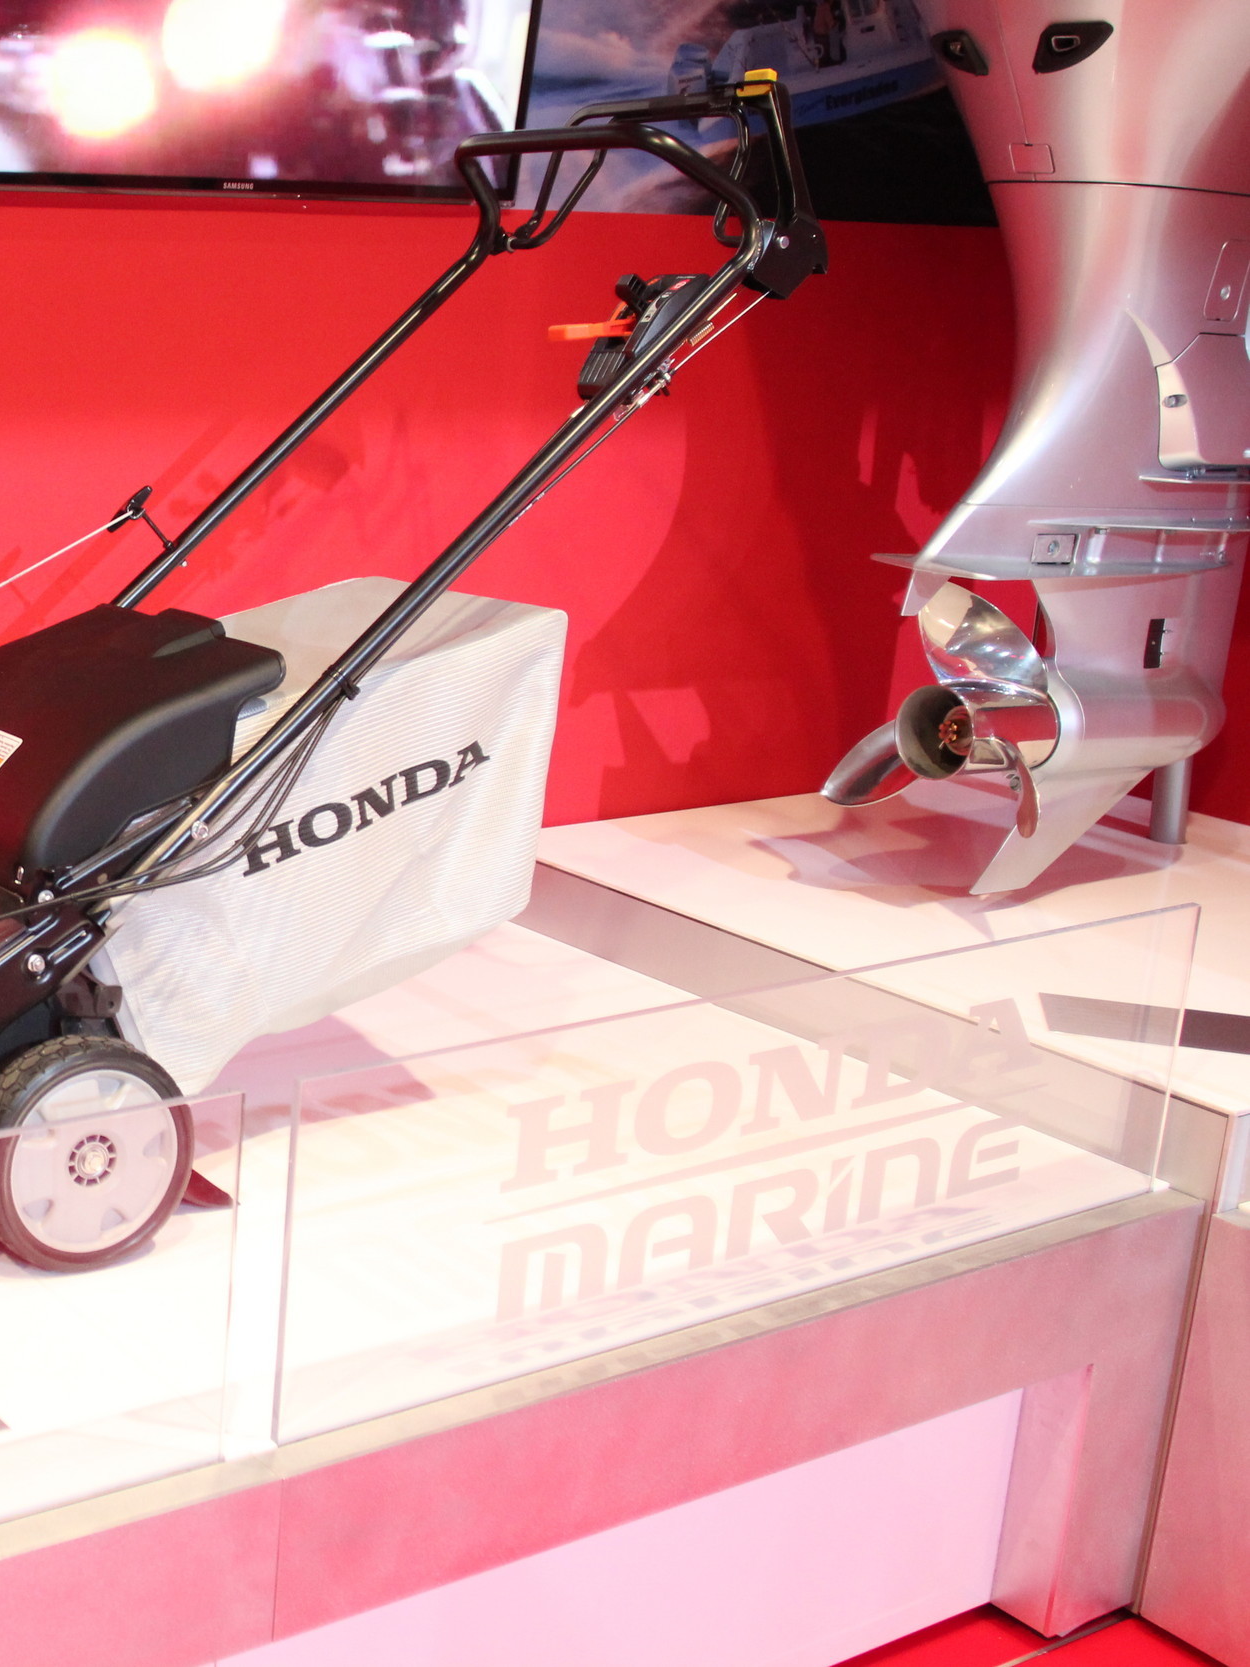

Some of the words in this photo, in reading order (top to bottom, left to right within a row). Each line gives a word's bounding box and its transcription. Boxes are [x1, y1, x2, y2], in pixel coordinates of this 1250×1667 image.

[222, 181, 254, 190] SAMSUNG
[235, 740, 491, 878] HONDA
[499, 997, 1043, 1194] HONDA
